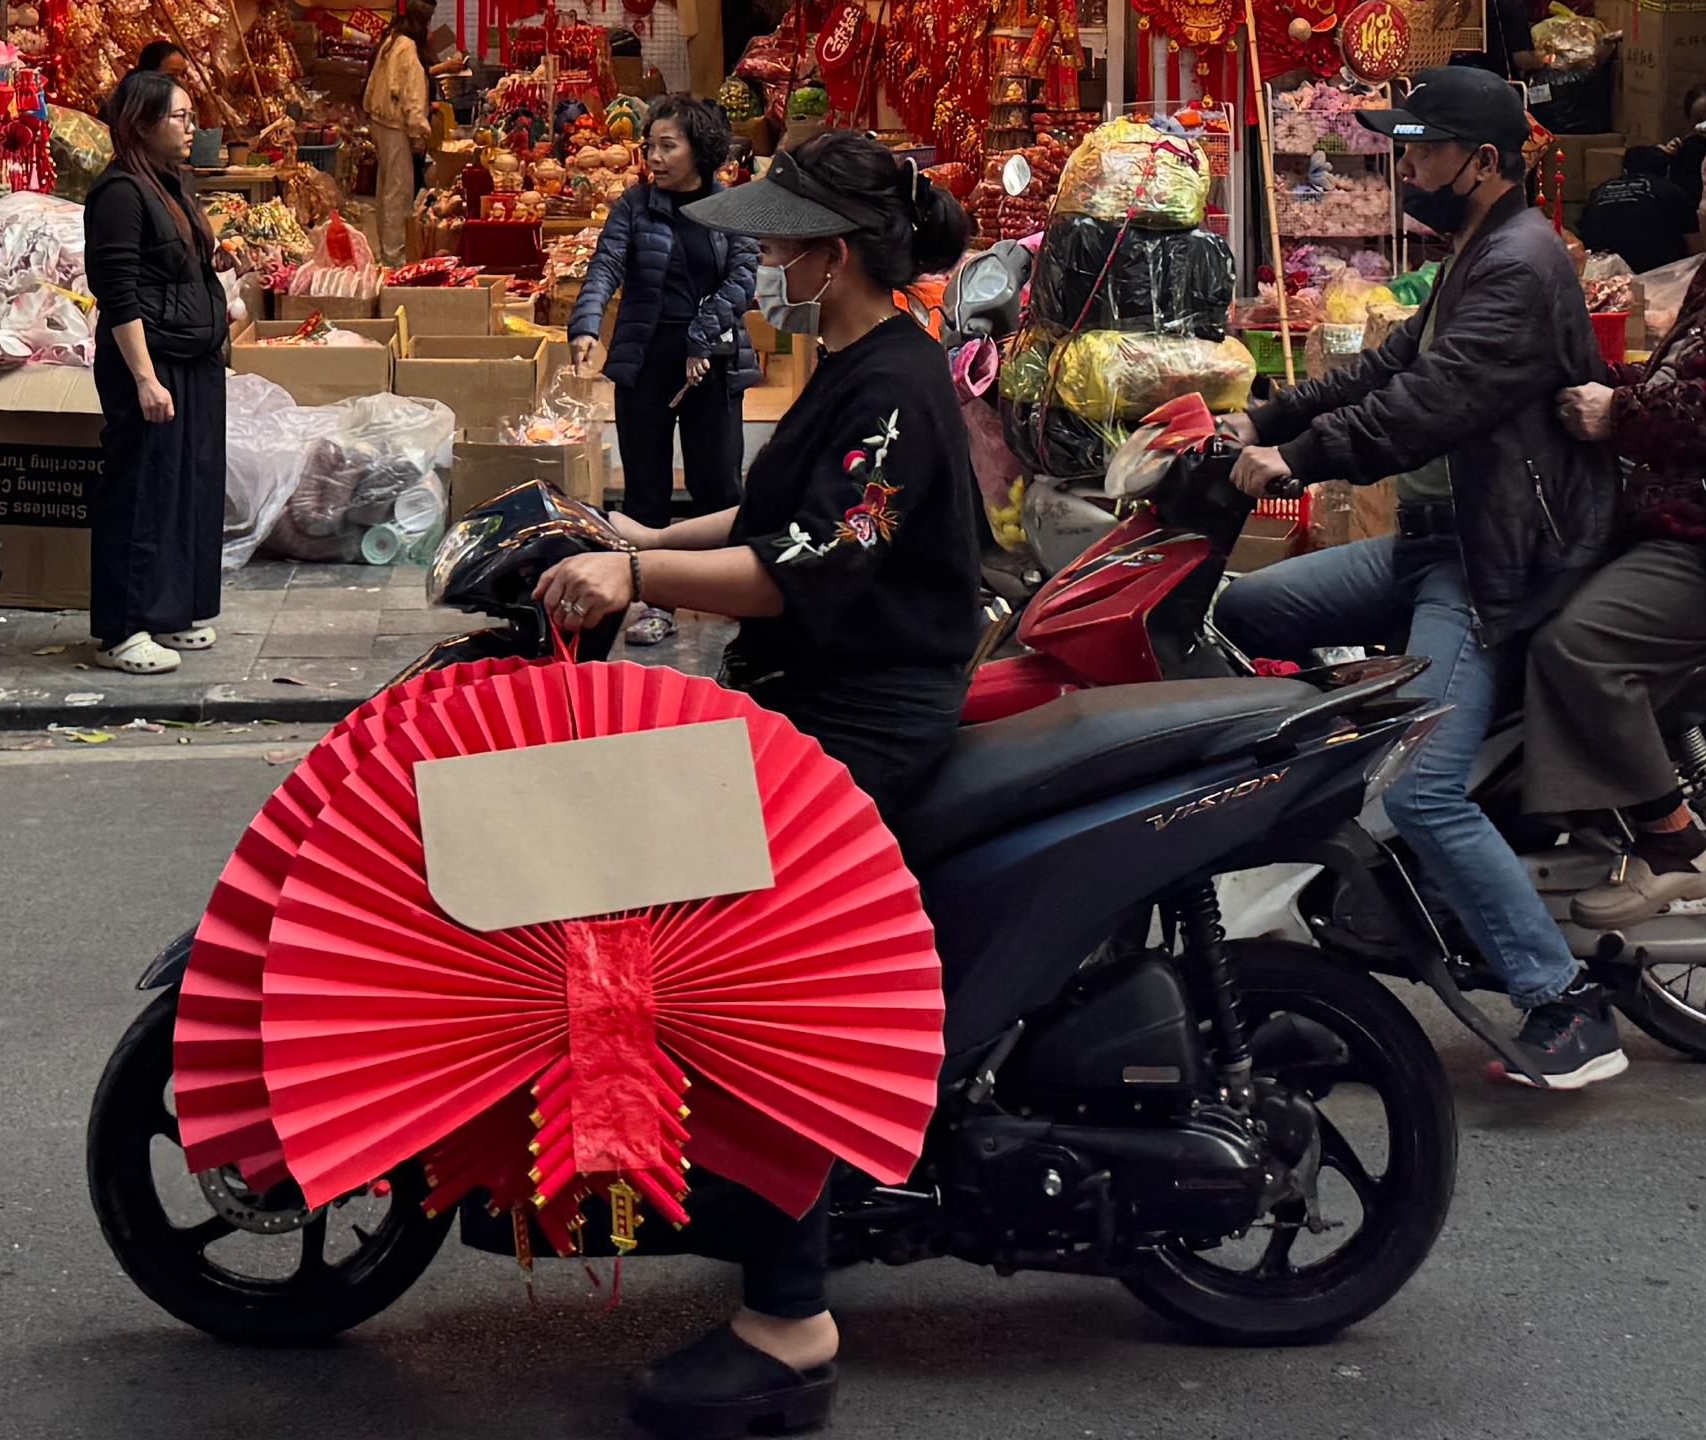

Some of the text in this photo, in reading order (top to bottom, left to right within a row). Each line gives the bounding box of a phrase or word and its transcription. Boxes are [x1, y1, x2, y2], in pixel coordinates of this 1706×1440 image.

[17, 477, 84, 497] Rotating
[13, 499, 89, 520] Stainless
[1144, 766, 1291, 832] VISION
